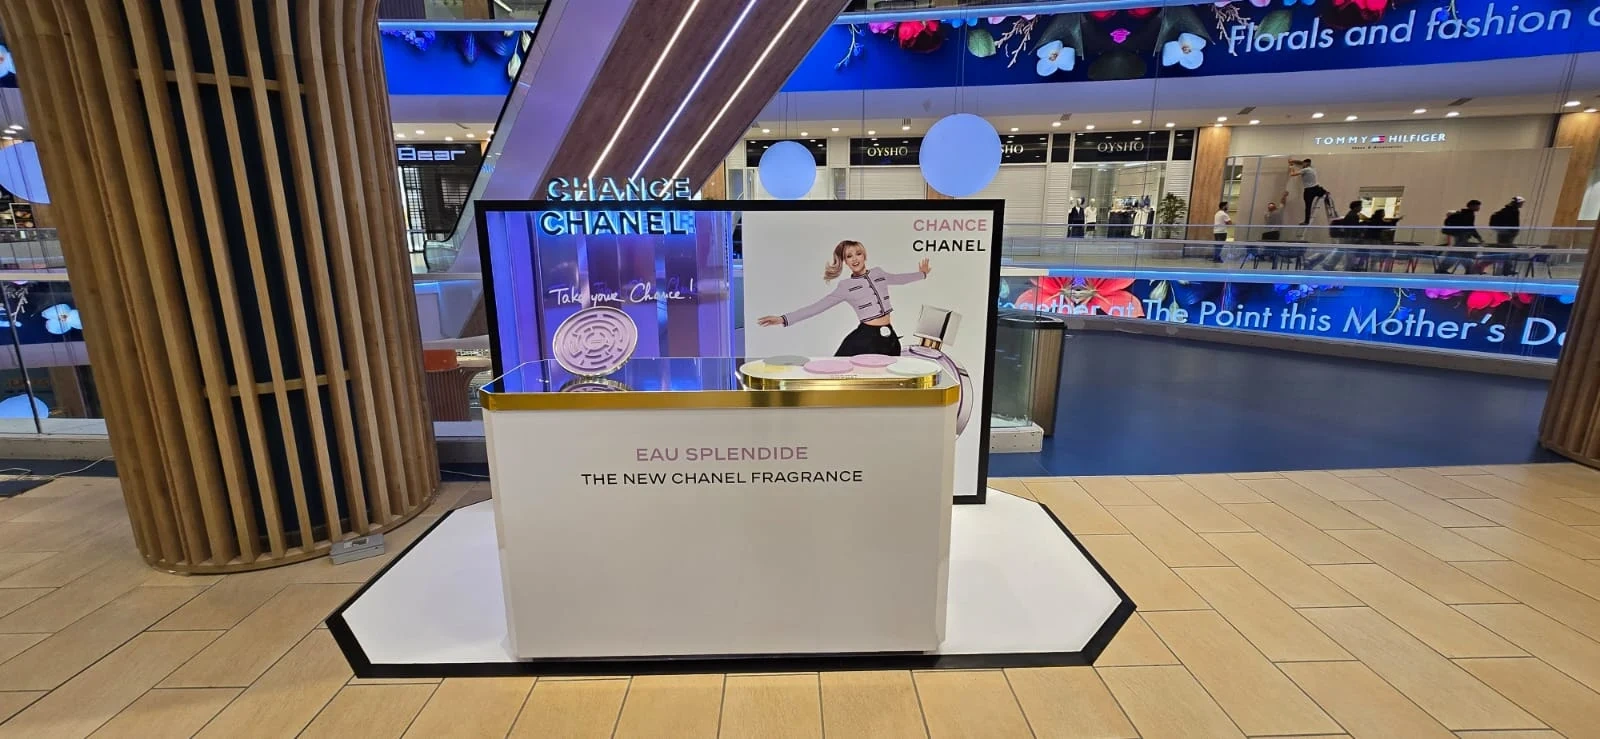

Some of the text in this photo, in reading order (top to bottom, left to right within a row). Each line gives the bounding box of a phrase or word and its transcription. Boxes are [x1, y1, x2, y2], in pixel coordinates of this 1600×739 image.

[1228, 17, 1334, 53] Florals
[1345, 10, 1415, 47] and
[1425, 3, 1571, 41] fashion
[1097, 140, 1145, 152] OYSHO
[1315, 133, 1446, 145] TOMMY HILFIGER
[397, 147, 466, 161] Bear
[867, 146, 908, 157] OYSHO
[1000, 143, 1024, 154] SHO
[546, 177, 691, 201] CHANCE
[539, 210, 690, 236] CHANEL
[913, 218, 988, 232] CHANCE
[912, 239, 987, 252] CHANEL
[1109, 301, 1135, 318] at
[1142, 299, 1189, 324] The
[1199, 301, 1272, 328] Point
[1281, 303, 1331, 331] this
[1342, 306, 1505, 343] Mother's
[1520, 317, 1568, 347] D
[636, 446, 809, 462] EAU SPLENDIDE
[581, 470, 863, 486] THE NEW CHANEL FRAGRANCE
